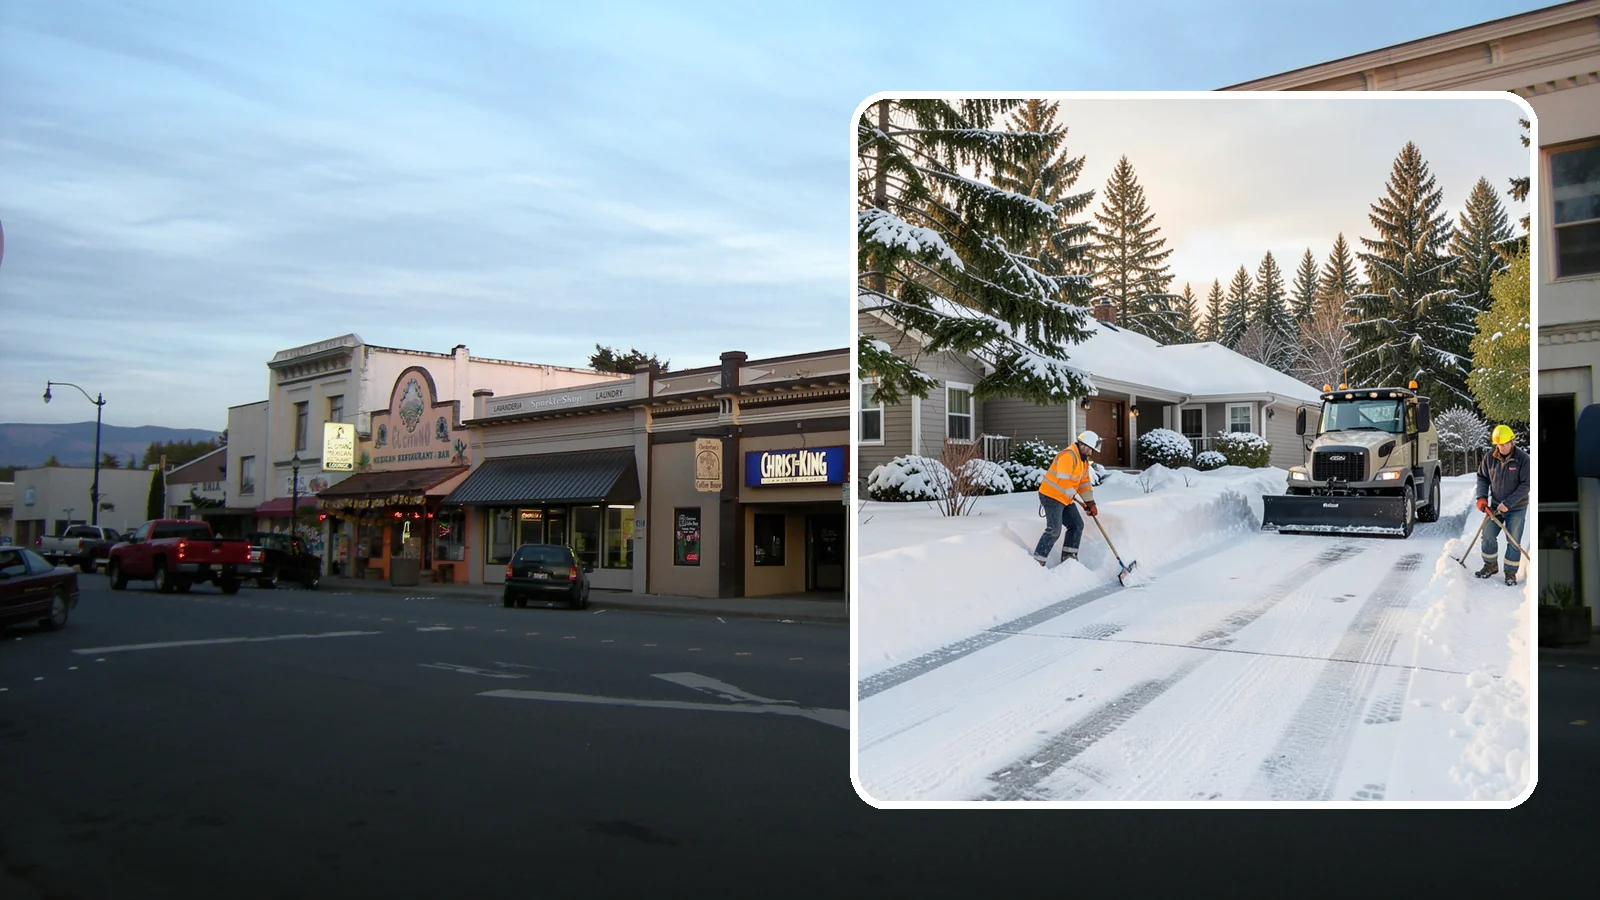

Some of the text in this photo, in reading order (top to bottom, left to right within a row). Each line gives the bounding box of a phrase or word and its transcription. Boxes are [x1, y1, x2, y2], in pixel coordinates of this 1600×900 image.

[595, 389, 623, 400] LAUNDRY
[493, 401, 522, 413] LAVANDERIA
[530, 394, 582, 410] Sparkle Shop
[373, 450, 450, 464] MEXICAN RESTAURANT BAR
[760, 450, 827, 478] CHRIST KING
[696, 480, 722, 489] Coffee House
